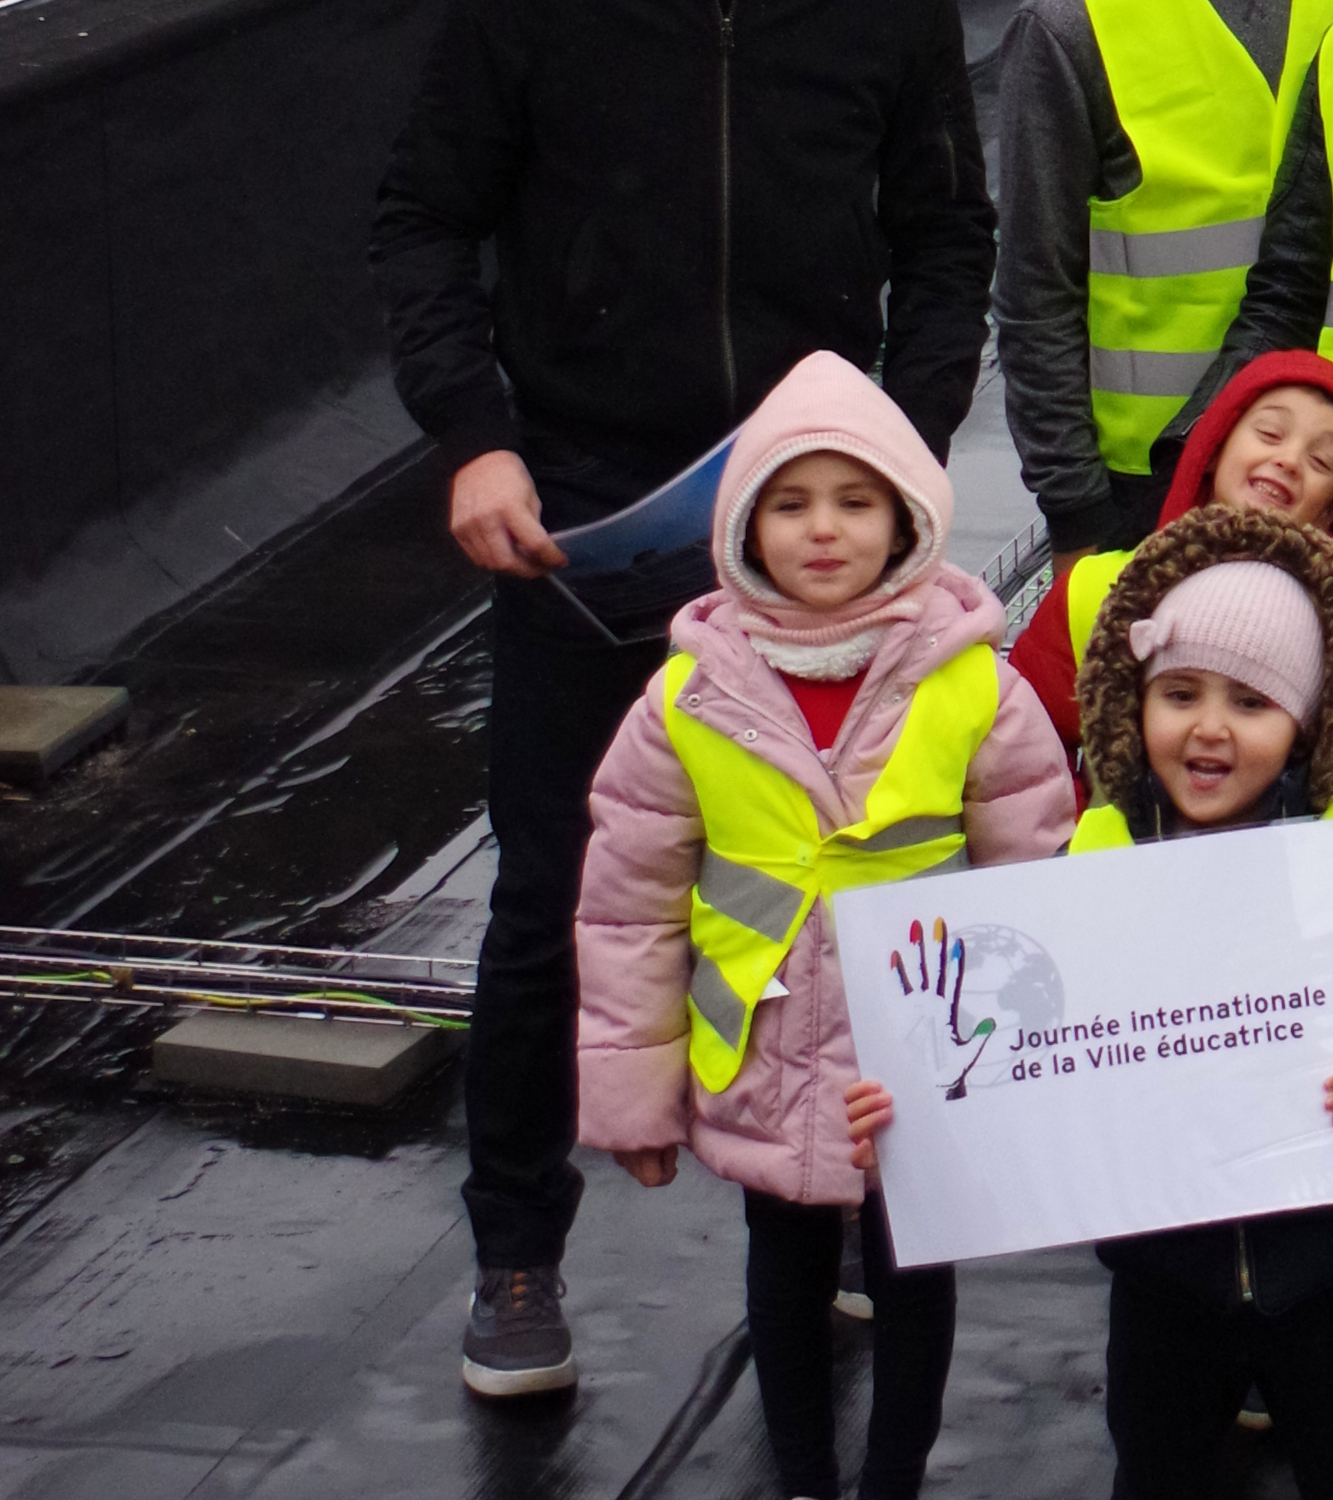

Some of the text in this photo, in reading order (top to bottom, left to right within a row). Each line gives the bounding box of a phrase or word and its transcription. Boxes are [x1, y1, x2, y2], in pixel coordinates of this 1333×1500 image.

[1009, 986, 1326, 1052] Journée internationale
[1011, 1021, 1305, 1081] de la Ville éducatrice
